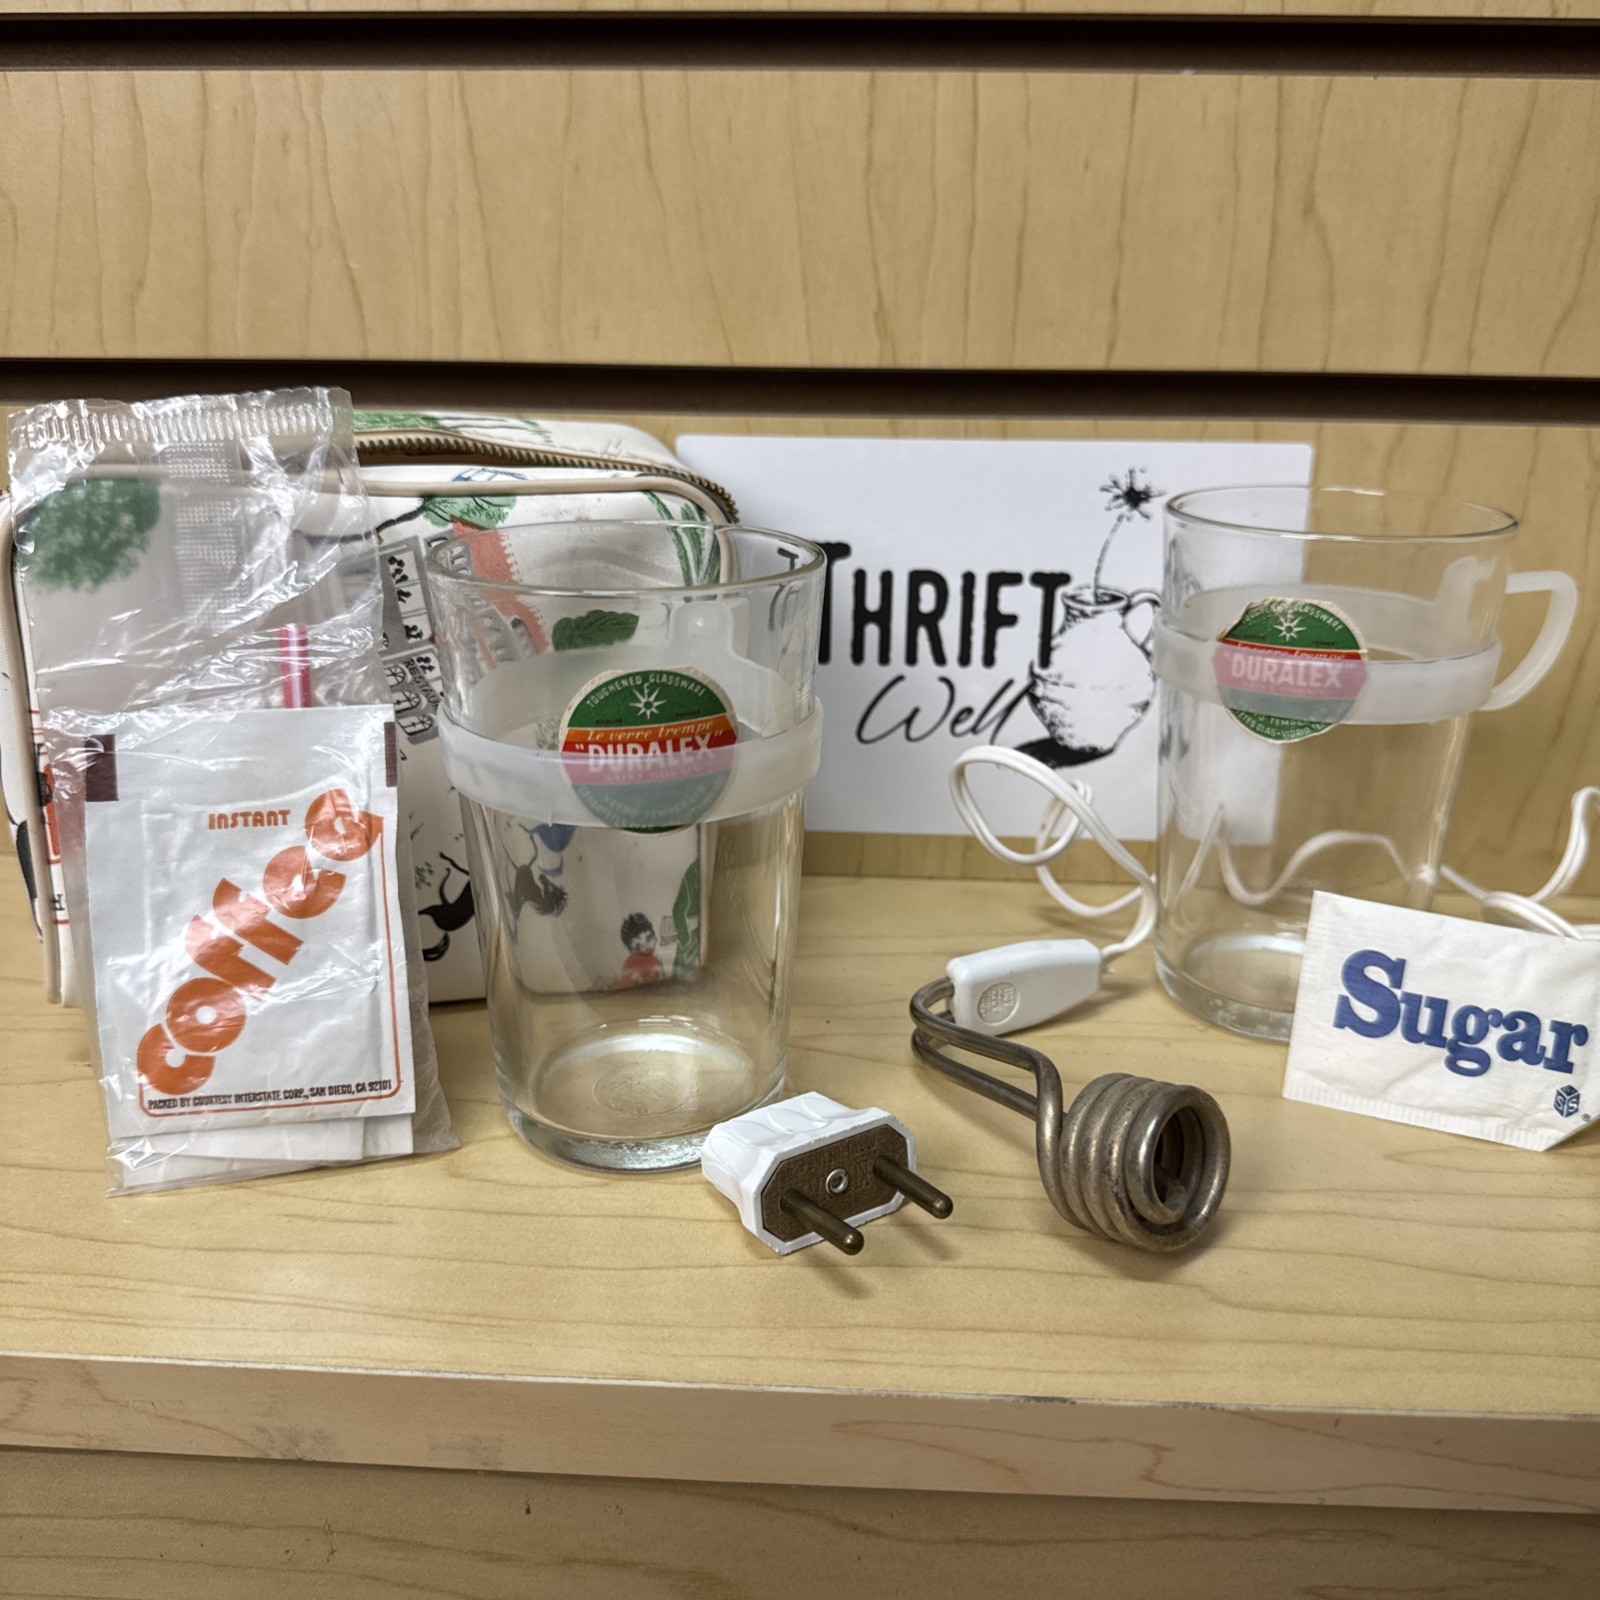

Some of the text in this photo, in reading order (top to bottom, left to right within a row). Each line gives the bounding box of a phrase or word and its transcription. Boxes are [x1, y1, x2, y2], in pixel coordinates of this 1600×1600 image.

[813, 541, 1071, 669] THRIFT
[1294, 604, 1344, 632] GLASSWARE
[587, 675, 643, 708] TOUGHENED
[649, 673, 706, 698] GLASSWARE
[856, 674, 1034, 744] Well
[609, 729, 652, 741] verre
[208, 808, 291, 830] INSTANT
[137, 787, 383, 1095] coffee
[1332, 949, 1588, 1078] Sugar
[148, 1098, 178, 1110] PACKED
[180, 1097, 191, 1108] BY
[234, 1090, 282, 1104] INTERSTATE
[309, 1086, 326, 1097] SAN
[328, 1084, 355, 1096] DIEGO,
[356, 1082, 367, 1093] CA
